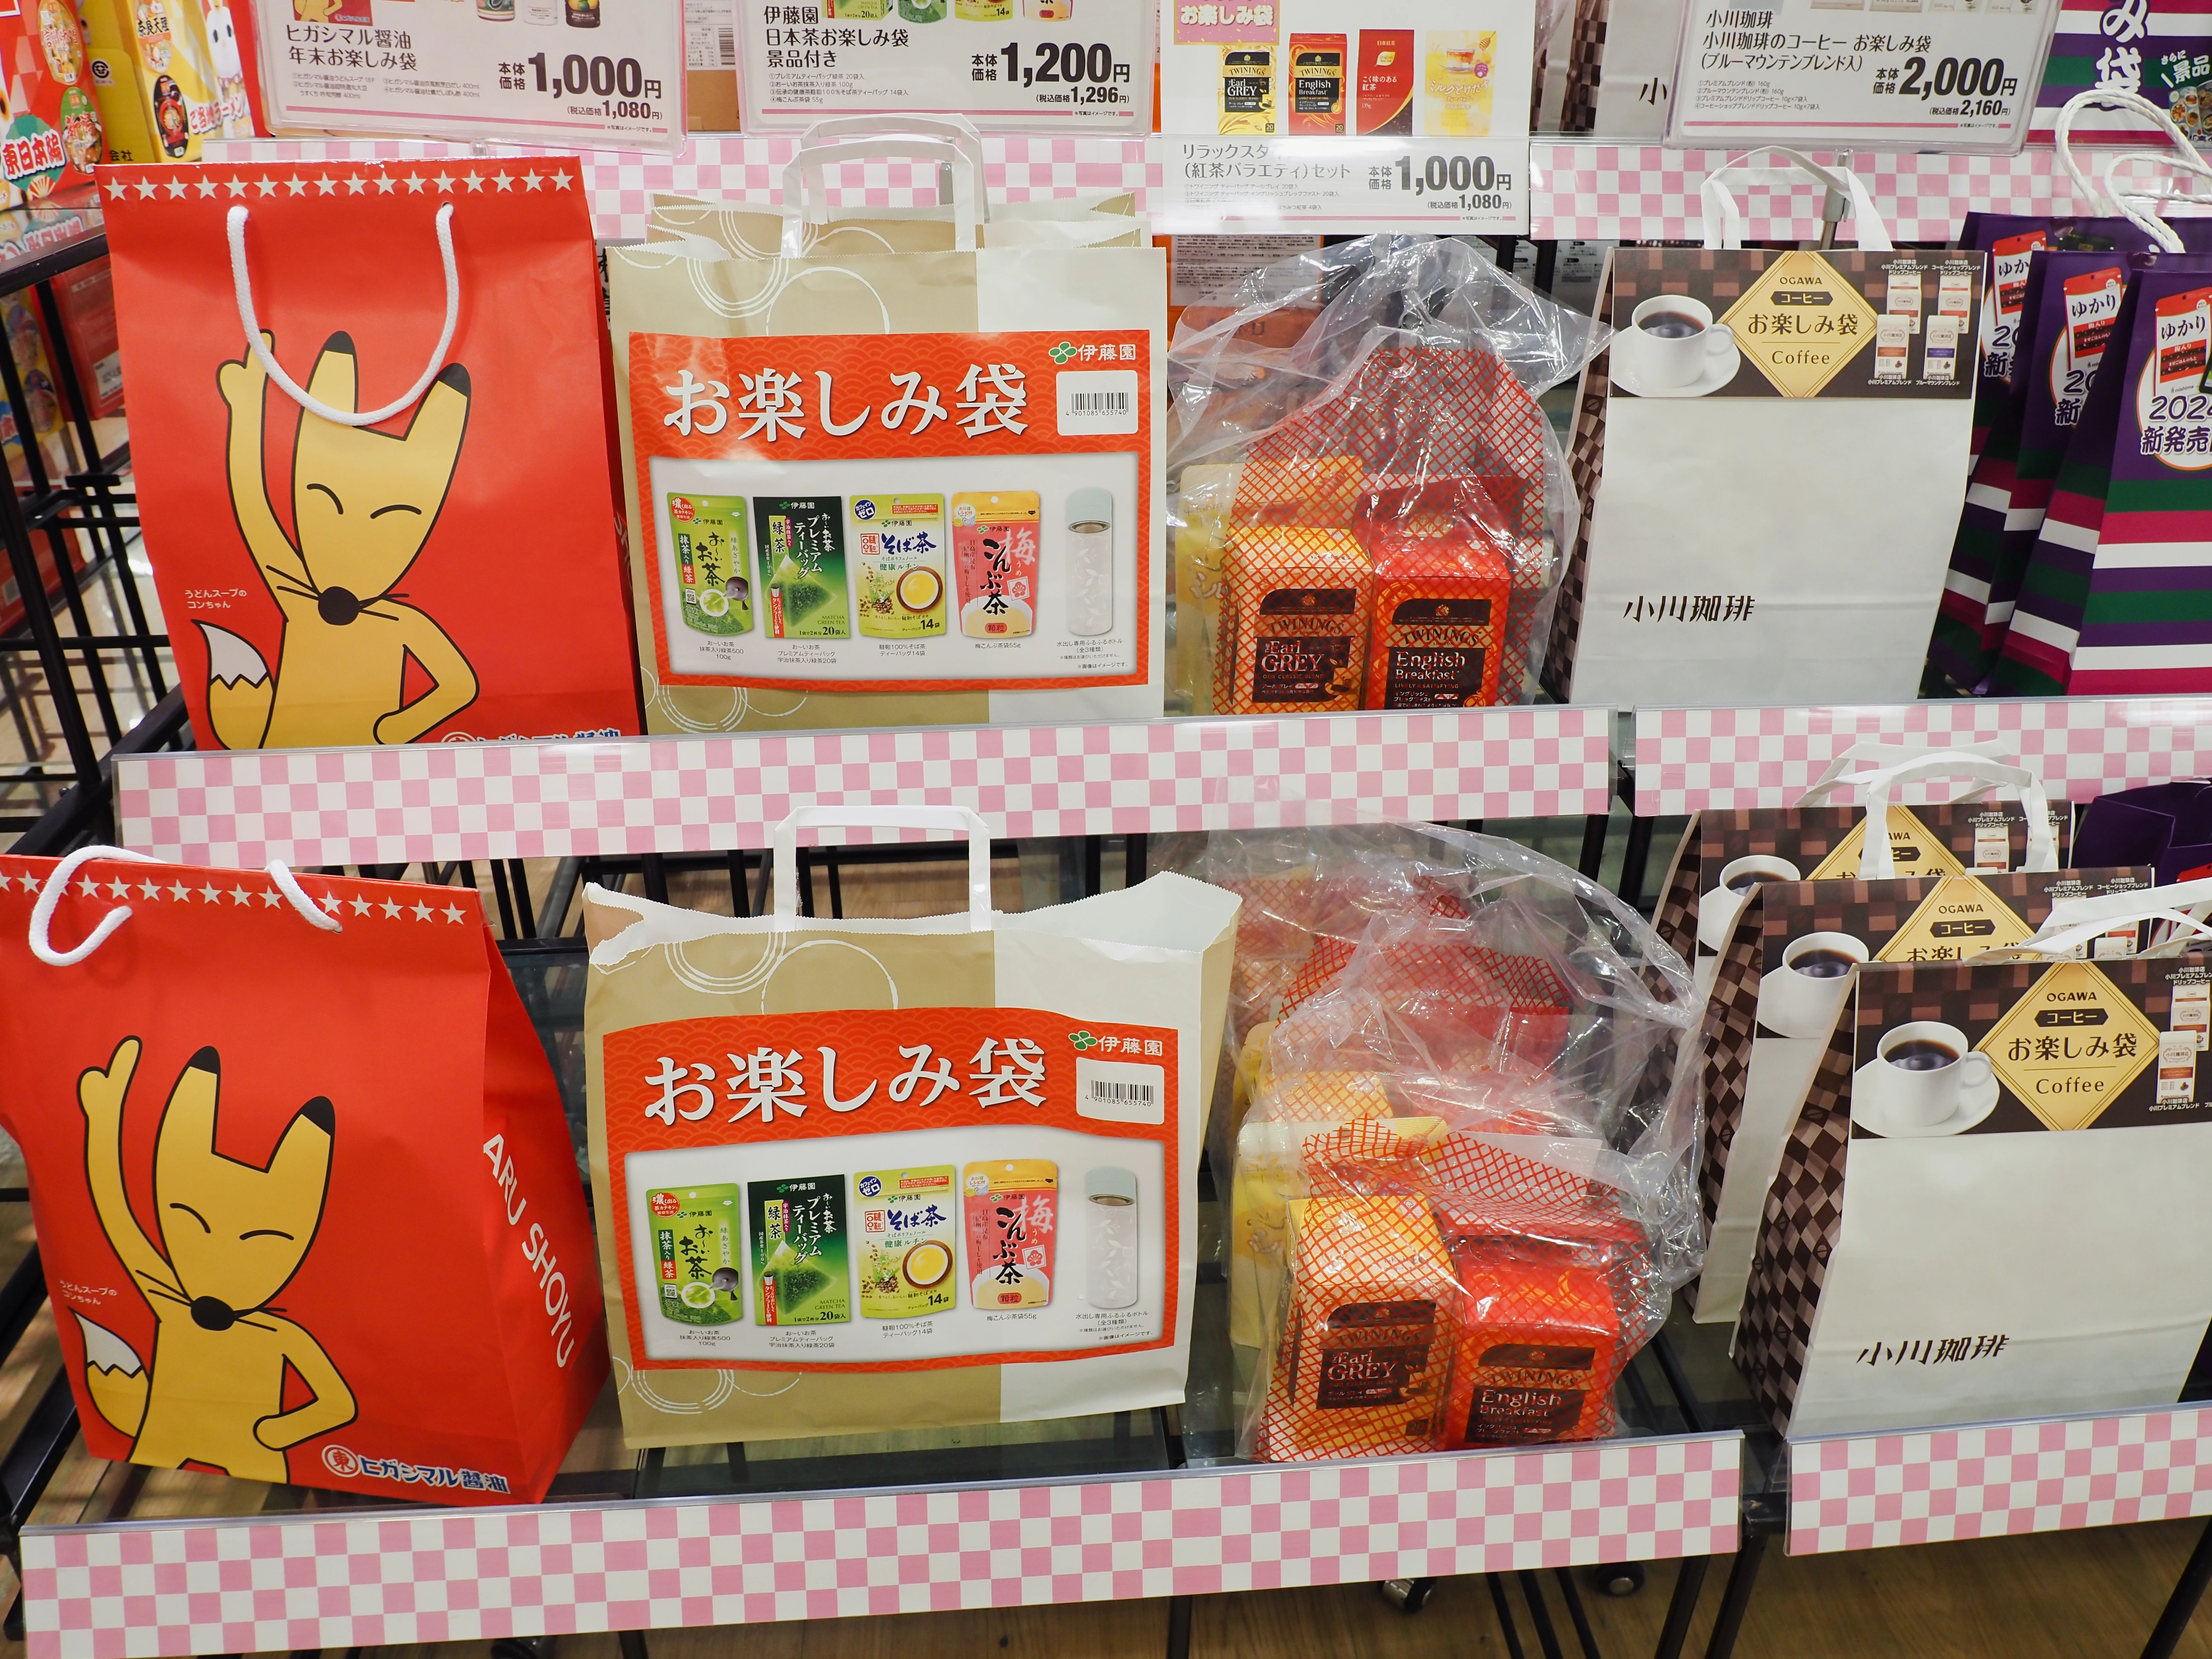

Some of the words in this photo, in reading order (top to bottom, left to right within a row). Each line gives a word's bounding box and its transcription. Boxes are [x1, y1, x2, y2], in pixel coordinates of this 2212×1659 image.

[764, 6, 818, 25] 伊藤園
[1181, 4, 1274, 26] お楽しみ袋
[1706, 9, 1774, 29] 小川珈琲
[286, 24, 412, 49] ヒガシマル醤油
[766, 28, 909, 47] 日本茶お楽しみ袋
[1703, 31, 1847, 50] 小川珈琲のコーヒー
[1854, 34, 1931, 54] お楽しみ袋
[288, 45, 418, 72] 年末お楽しみ袋
[767, 50, 837, 68] 景品付き
[972, 55, 998, 67] 本体
[1001, 42, 1130, 87] 1,200円
[2161, 50, 2186, 65] さらに
[499, 62, 525, 76] 本体
[528, 52, 662, 99] 1,000円
[972, 68, 998, 81] 価格
[1229, 66, 1266, 76] TWININGS
[1300, 67, 1337, 77] TWININGS
[1876, 68, 1899, 80] 本体
[2173, 55, 2210, 84] 景品
[499, 76, 526, 91] 価格
[1299, 79, 1331, 90] English
[1362, 83, 1377, 91] 紅茶
[1899, 57, 2017, 100] 2,000円
[1227, 86, 1257, 96] GREY
[1873, 82, 1895, 94] 価格
[1368, 166, 1392, 178] 本体
[1395, 156, 1512, 196] 1,000円
[1368, 179, 1392, 191] 価格
[1779, 276, 1823, 285] OGAWA
[1781, 293, 1824, 304] コーヒー
[2072, 293, 2118, 319] ゆかり
[1748, 312, 1858, 336] お楽しみ袋
[2161, 316, 2207, 341] ゆかり
[1077, 343, 1137, 361] 伊藤園
[1772, 349, 1831, 365] Coffee
[664, 363, 1029, 442] お楽しみ袋
[772, 521, 786, 553] 緑茶
[807, 515, 823, 573] プレミアム
[881, 531, 937, 555] そば茶
[998, 527, 1036, 565] 梅
[731, 536, 740, 573] 緑あざやか
[794, 522, 810, 579] ティーバッグ
[879, 563, 920, 571] 健康ルチン
[980, 538, 1011, 615] こんぶ茶
[184, 589, 247, 598] うどんスープの
[187, 600, 231, 609] コンちゃん
[1623, 595, 1755, 623] 小川珈琲
[987, 624, 1005, 632] 顆粒
[1267, 617, 1344, 635] TWININGS
[1056, 638, 1123, 647] 水出し専用ふるふるボトル
[1400, 628, 1479, 646] TWININGS
[1270, 640, 1301, 654] Earl
[1261, 654, 1324, 672] GREY
[1396, 652, 1466, 670] English
[1395, 669, 1456, 680] Breakfast
[2043, 885, 2093, 893] 小川プレミアムブレンド
[2097, 882, 2148, 890] コーヒーショップブレンド
[1938, 903, 1985, 914] OGAWA
[1941, 922, 1986, 934] コーヒー
[2046, 991, 2098, 1002] OGAWA
[2046, 1011, 2098, 1023] コーヒー
[1097, 1036, 1164, 1057] 伊藤園
[2008, 1033, 2137, 1062] お楽しみ袋
[644, 1036, 1047, 1126] お楽しみ袋
[2035, 1077, 2104, 1095] Coffee
[2148, 1103, 2200, 1112] 小川プレミアムブレンド
[789, 1182, 816, 1192] 伊藤園
[862, 1183, 880, 1196] ゼロ
[898, 1194, 921, 1202] 伊藤園
[767, 1205, 783, 1240] 緑茶
[887, 1204, 947, 1231] そば茶
[1013, 1195, 1054, 1234] 梅
[792, 1205, 809, 1265] ティーバッグ
[807, 1196, 822, 1257] プレミアム
[720, 1227, 730, 1265] 緑あざやか
[885, 1238, 928, 1248] 健康ルチン
[993, 1206, 1026, 1284] こんぶ茶
[60, 1280, 117, 1298] うどんスープの
[62, 1289, 102, 1306] コンちゃん
[521, 1222, 575, 1368] SHOYU
[1000, 1295, 1020, 1303] 顆粒
[986, 1313, 1037, 1322] 梅こんぶ茶袋55g
[1075, 1311, 1149, 1320] 水出し専用ふるふるボトル
[883, 1328, 933, 1338] ティーバッグ14袋
[1338, 1350, 1373, 1364] Earl
[1856, 1334, 2010, 1366] 小川珈琲
[1327, 1362, 1399, 1381] GREY
[1482, 1389, 1562, 1407] English
[1480, 1405, 1549, 1417] Breakfast
[332, 1451, 355, 1473] 東
[360, 1455, 511, 1494] ヒガシマル醤油
